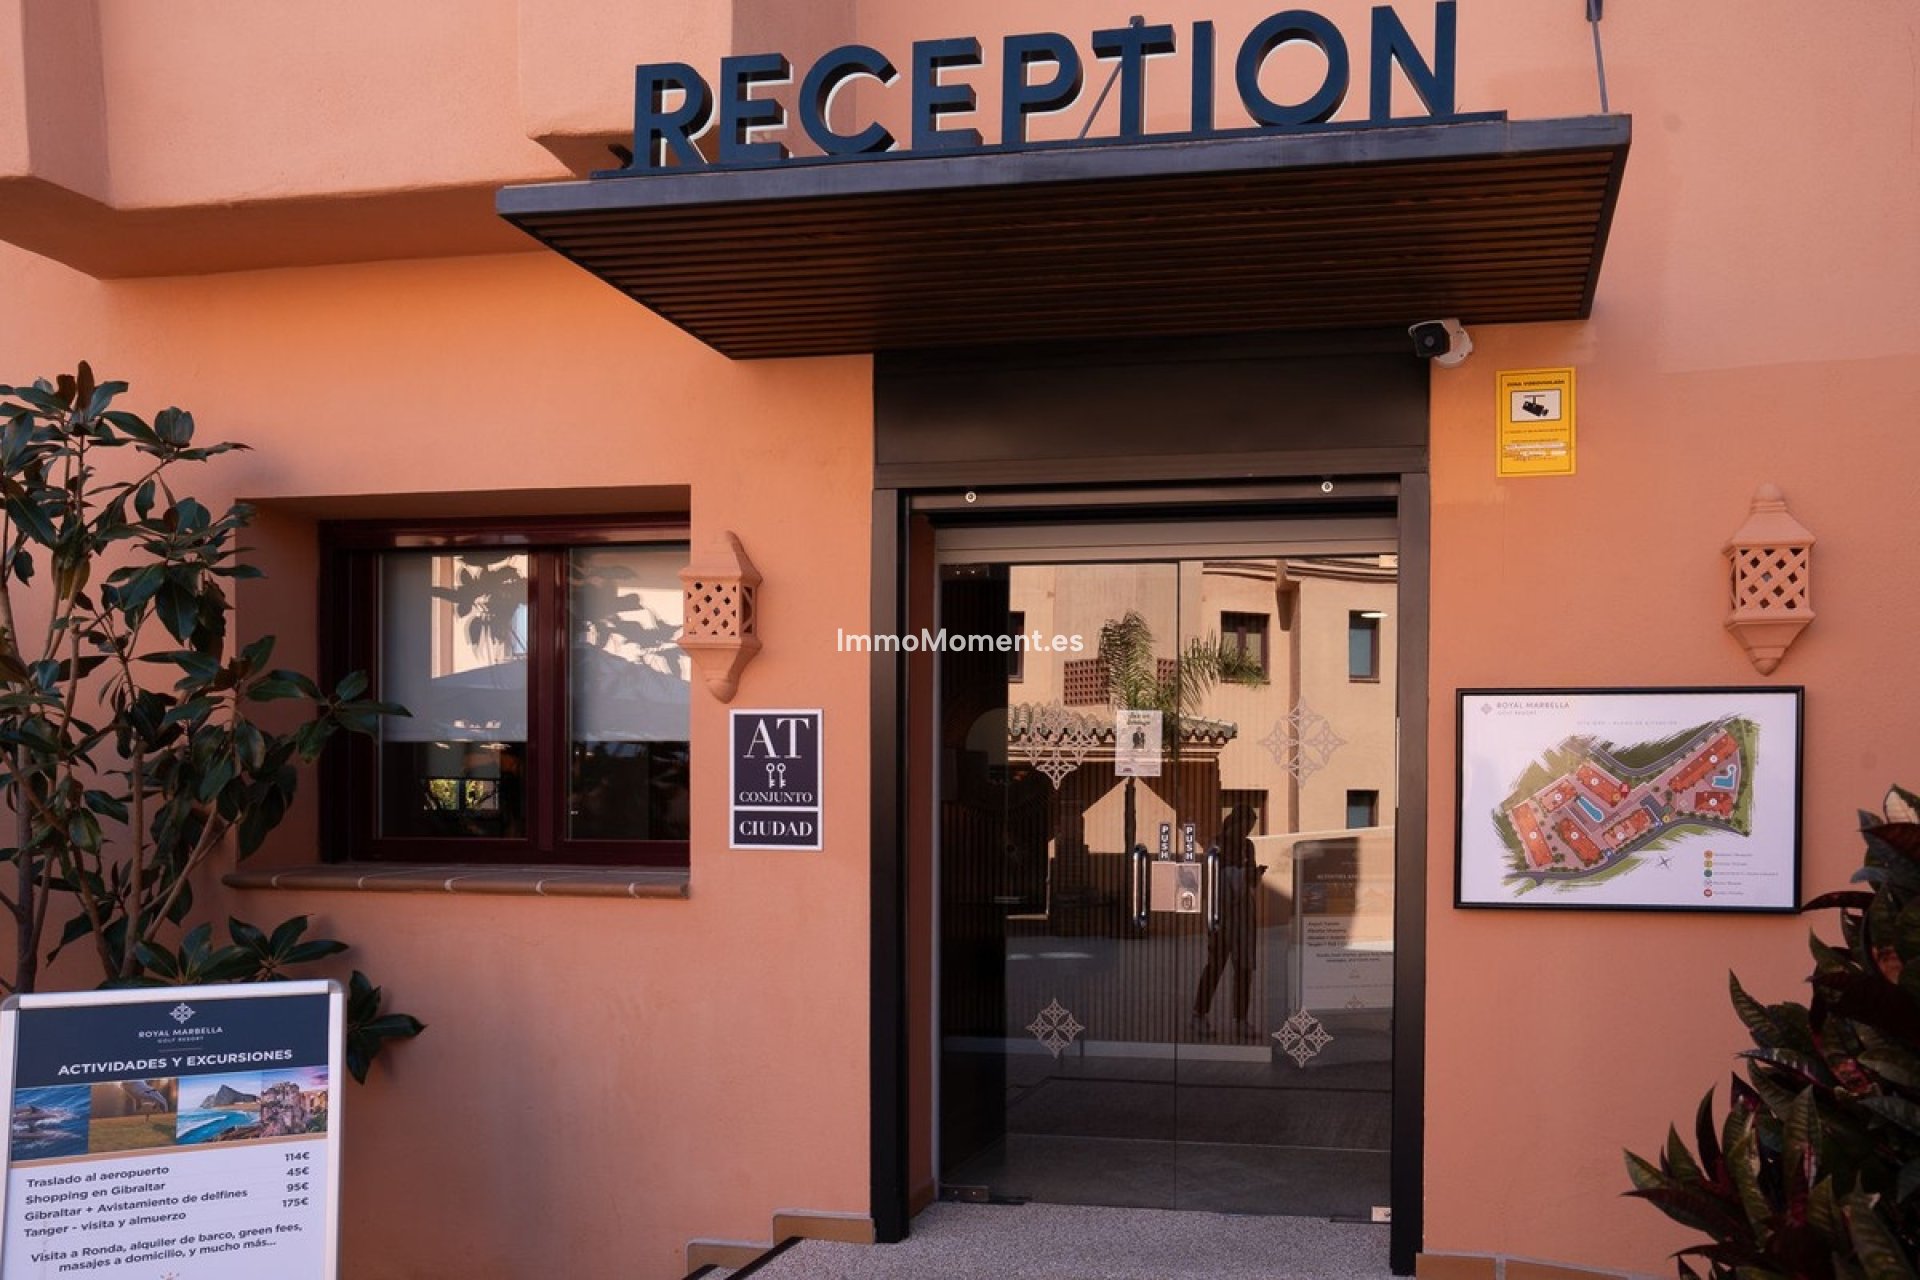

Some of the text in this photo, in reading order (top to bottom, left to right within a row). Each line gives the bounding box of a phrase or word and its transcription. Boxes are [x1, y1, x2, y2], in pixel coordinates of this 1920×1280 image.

[632, 0, 1458, 170] RECEPTION
[743, 717, 811, 759] AT
[739, 791, 814, 803] CONJUNTO
[739, 820, 814, 837] CIUDAD
[1161, 825, 1169, 859] PUSH
[138, 1026, 223, 1038] ROYAL MARBELLA
[57, 1048, 293, 1076] ACTIVIDADES Y EXCURSIONES
[285, 1152, 310, 1161] 114€
[26, 1166, 170, 1188] Traslado al aeropuerto
[286, 1166, 310, 1176] 45€
[25, 1182, 166, 1205] Shopping en Gibraltar
[286, 1182, 309, 1192] 95€
[24, 1208, 83, 1222] Gibraltar
[97, 1196, 180, 1213] Avistamiento
[182, 1194, 198, 1204] de
[200, 1190, 248, 1202] delfines
[282, 1197, 309, 1207] 175€
[24, 1225, 69, 1238] Tanger
[81, 1219, 115, 1231] visita
[118, 1219, 126, 1228] y
[129, 1212, 187, 1226] almuerzo
[31, 1223, 303, 1263] Visita a Ronda, alquiler de barco, green fees,
[59, 1258, 111, 1272] masajes
[113, 1257, 121, 1265] a
[125, 1248, 186, 1263] domicilio,
[188, 1248, 197, 1256] y
[199, 1242, 240, 1254] mucho
